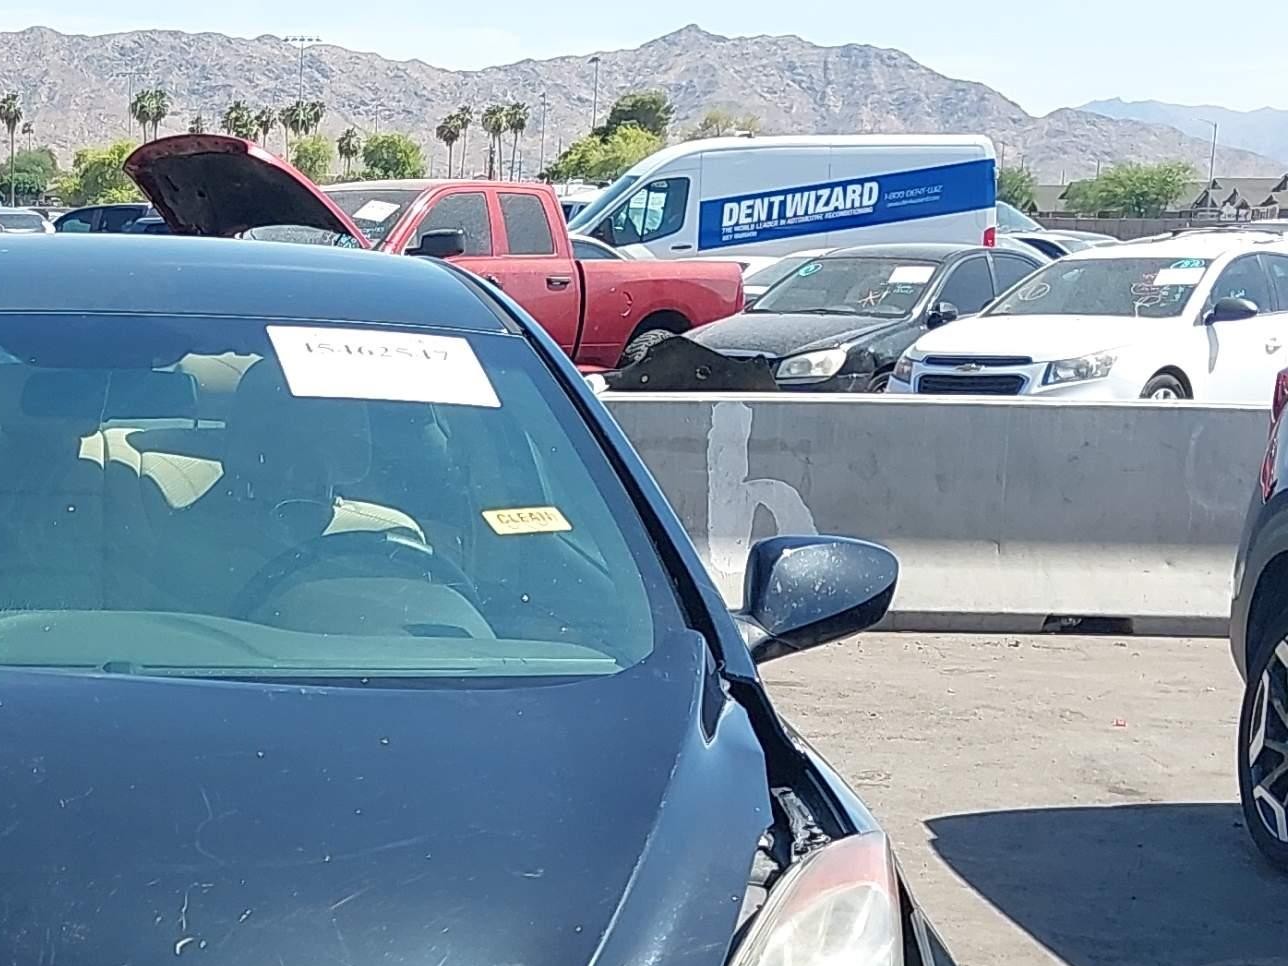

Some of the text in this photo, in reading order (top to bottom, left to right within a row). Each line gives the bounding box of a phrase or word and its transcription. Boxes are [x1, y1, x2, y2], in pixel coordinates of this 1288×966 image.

[722, 181, 879, 227] DENT WIZARD
[496, 511, 558, 525] CLEAN
